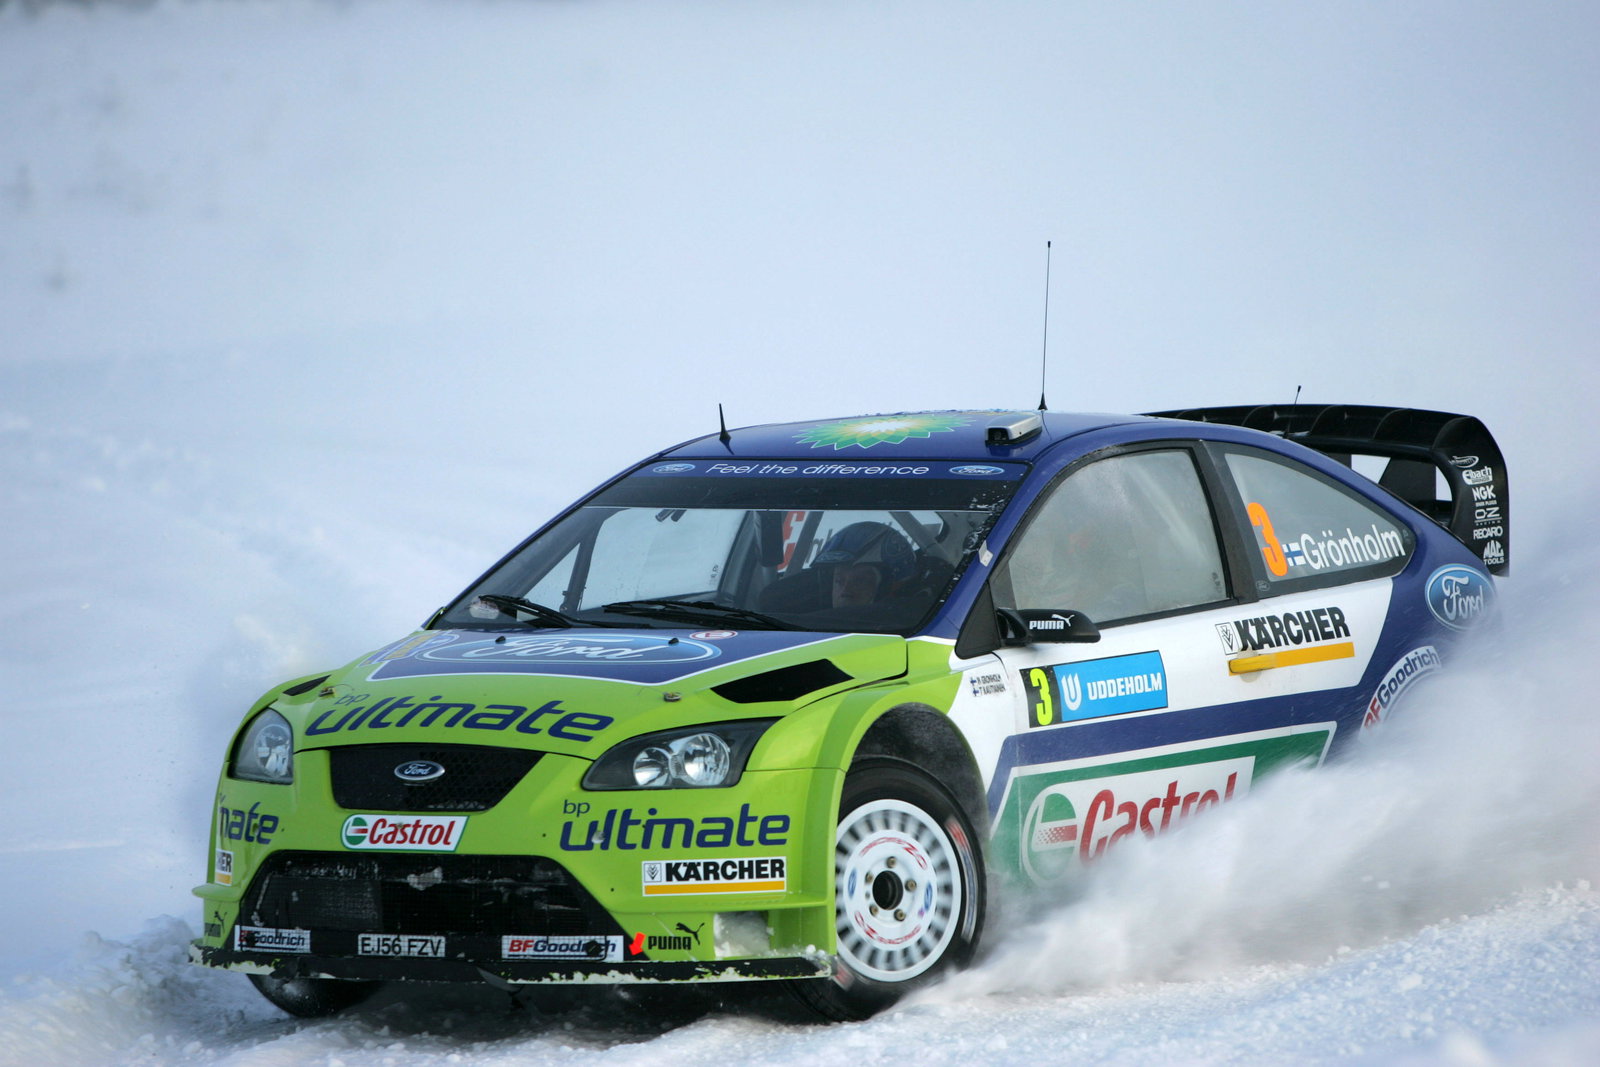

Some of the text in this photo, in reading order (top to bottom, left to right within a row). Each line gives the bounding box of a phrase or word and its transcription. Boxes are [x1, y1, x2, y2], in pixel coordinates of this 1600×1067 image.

[706, 463, 930, 475] Feel the difference
[1472, 485, 1496, 501] NGK
[1247, 502, 1406, 577] 3 Grönholm
[1473, 526, 1503, 540] RECARO
[1483, 540, 1504, 559] MAC
[1483, 557, 1504, 566] TOOLS
[1442, 575, 1484, 621] Ford
[1029, 620, 1065, 630] PUMA
[1234, 606, 1351, 651] KÄRCHER
[462, 639, 669, 660] Ford
[1087, 672, 1163, 700] UDDEHOLM
[333, 693, 371, 706] bp
[1030, 668, 1053, 726] 3
[305, 695, 614, 742] ultimate
[404, 763, 431, 776] Ford
[563, 800, 590, 817] bp
[369, 818, 455, 846] Castrol
[560, 803, 790, 850] ultimate
[665, 859, 785, 882] KÄRCHER
[361, 937, 442, 956] EJ56 FZV
[648, 936, 691, 950] PUMA
